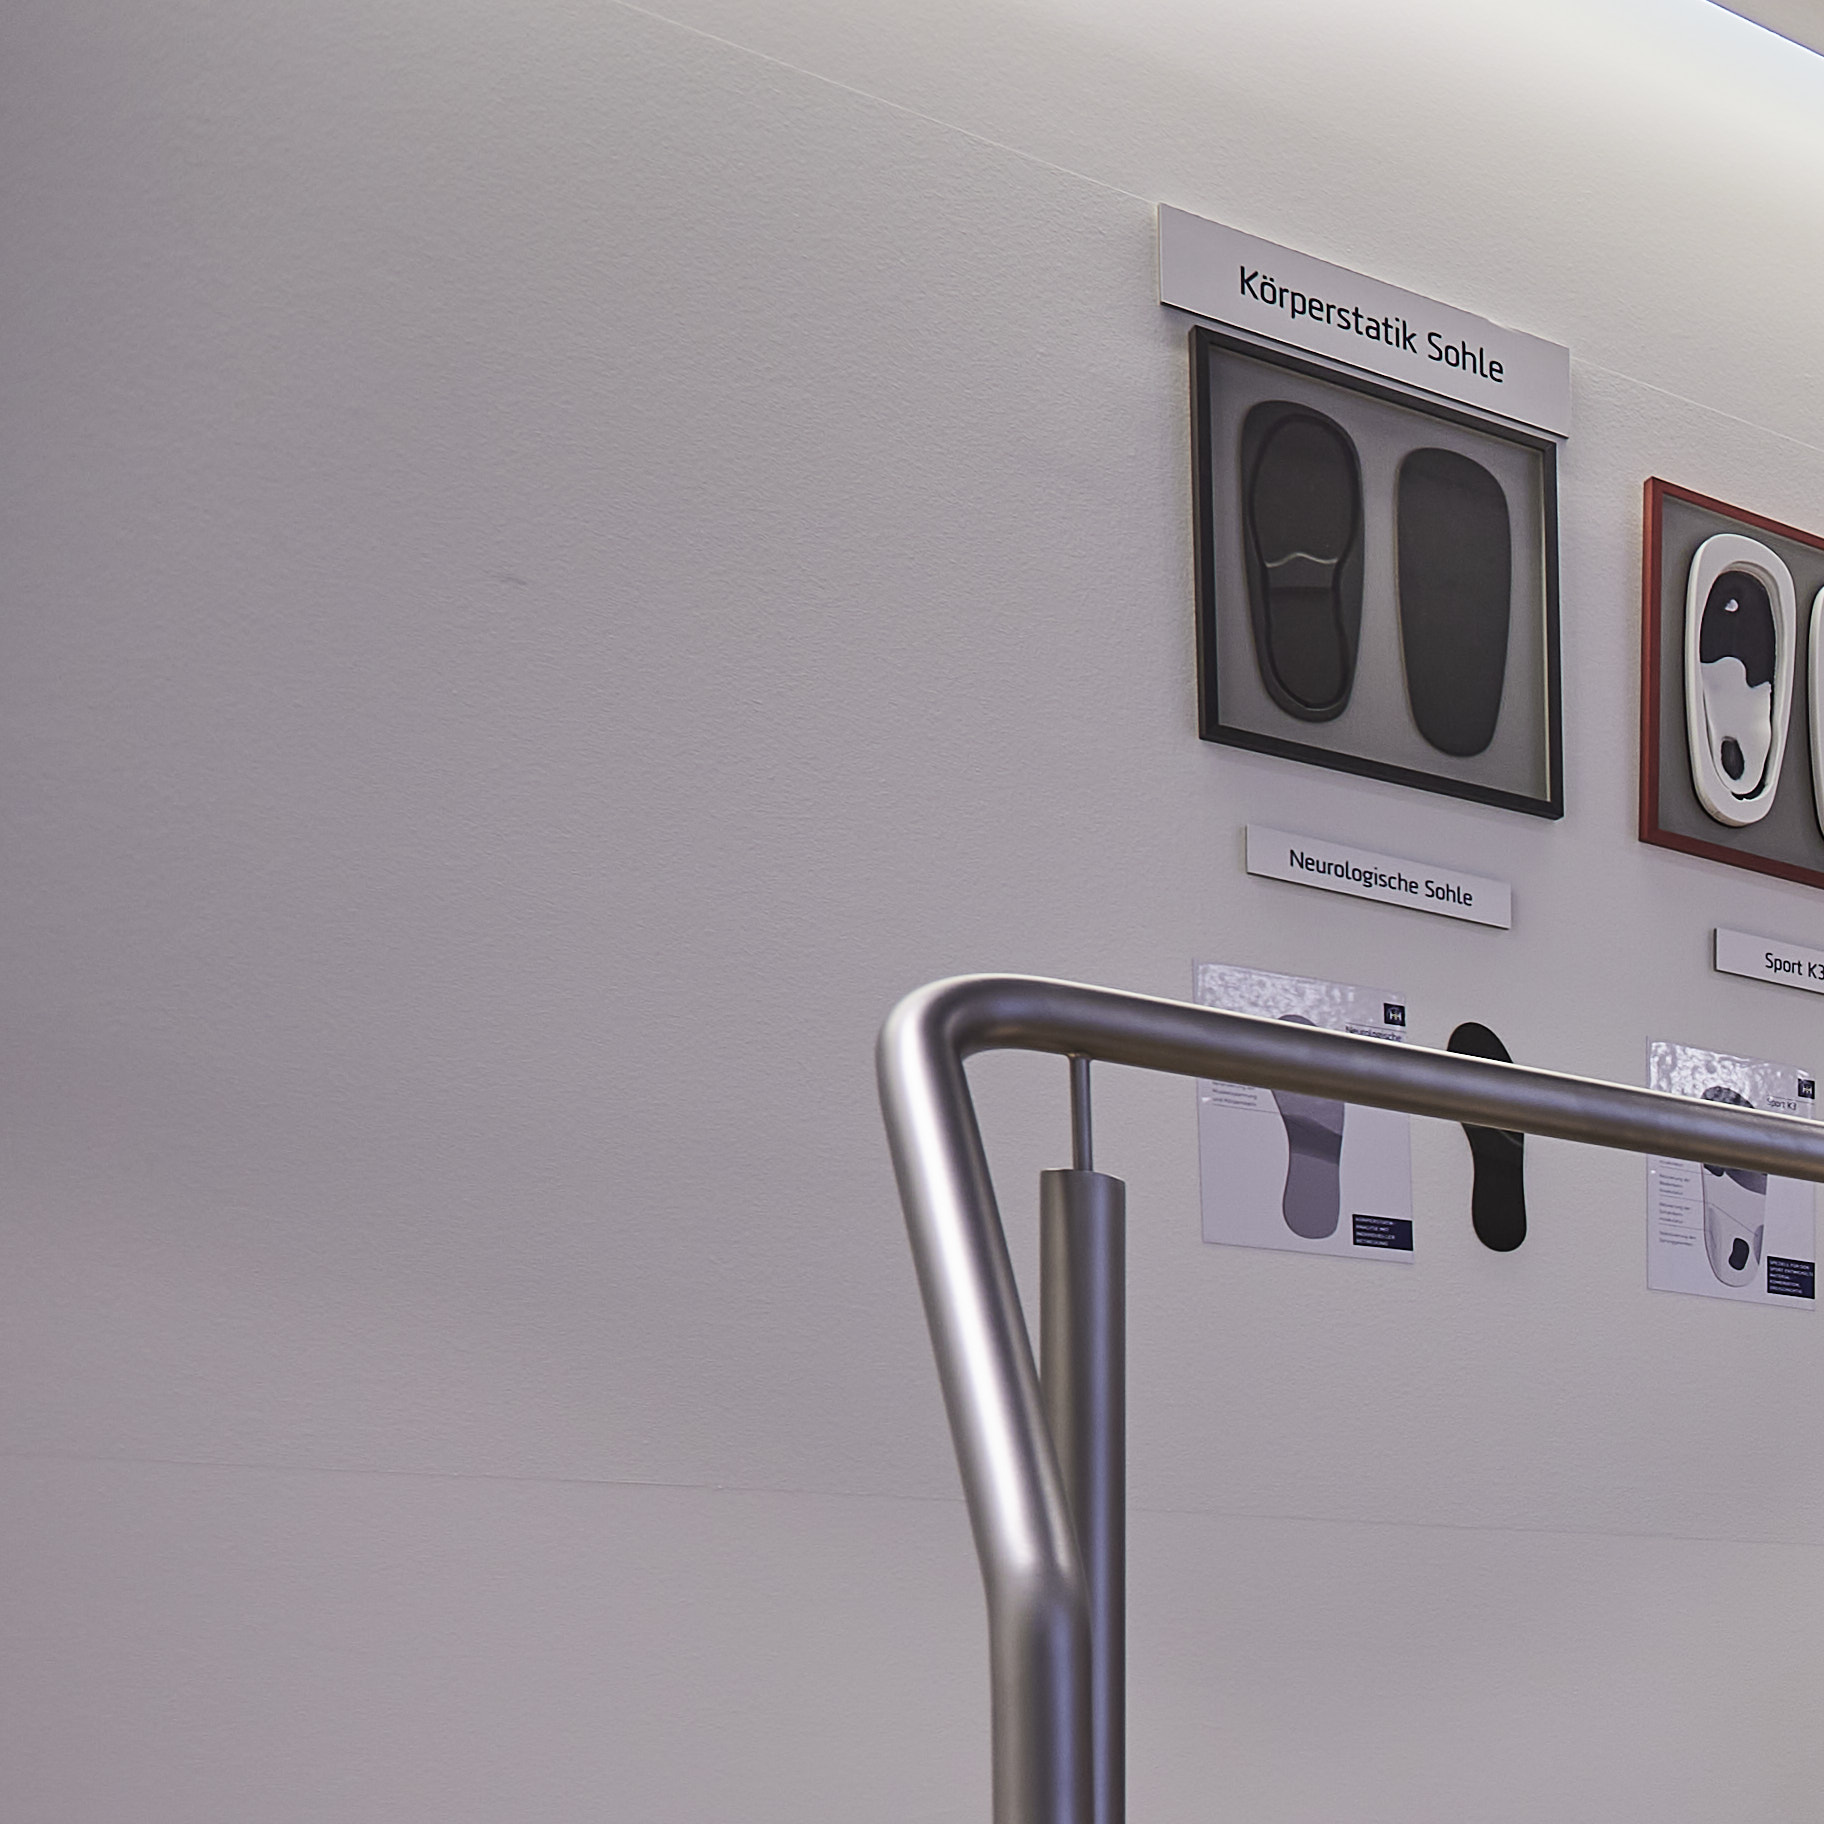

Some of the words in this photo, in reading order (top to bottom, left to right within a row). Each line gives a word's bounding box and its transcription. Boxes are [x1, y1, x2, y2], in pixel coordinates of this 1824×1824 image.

[1237, 265, 1418, 355] Körperstatik
[1427, 330, 1504, 384] Sohle
[1288, 848, 1420, 896] Neurologische
[1424, 879, 1474, 907] Sohle
[1765, 952, 1803, 977] Sport
